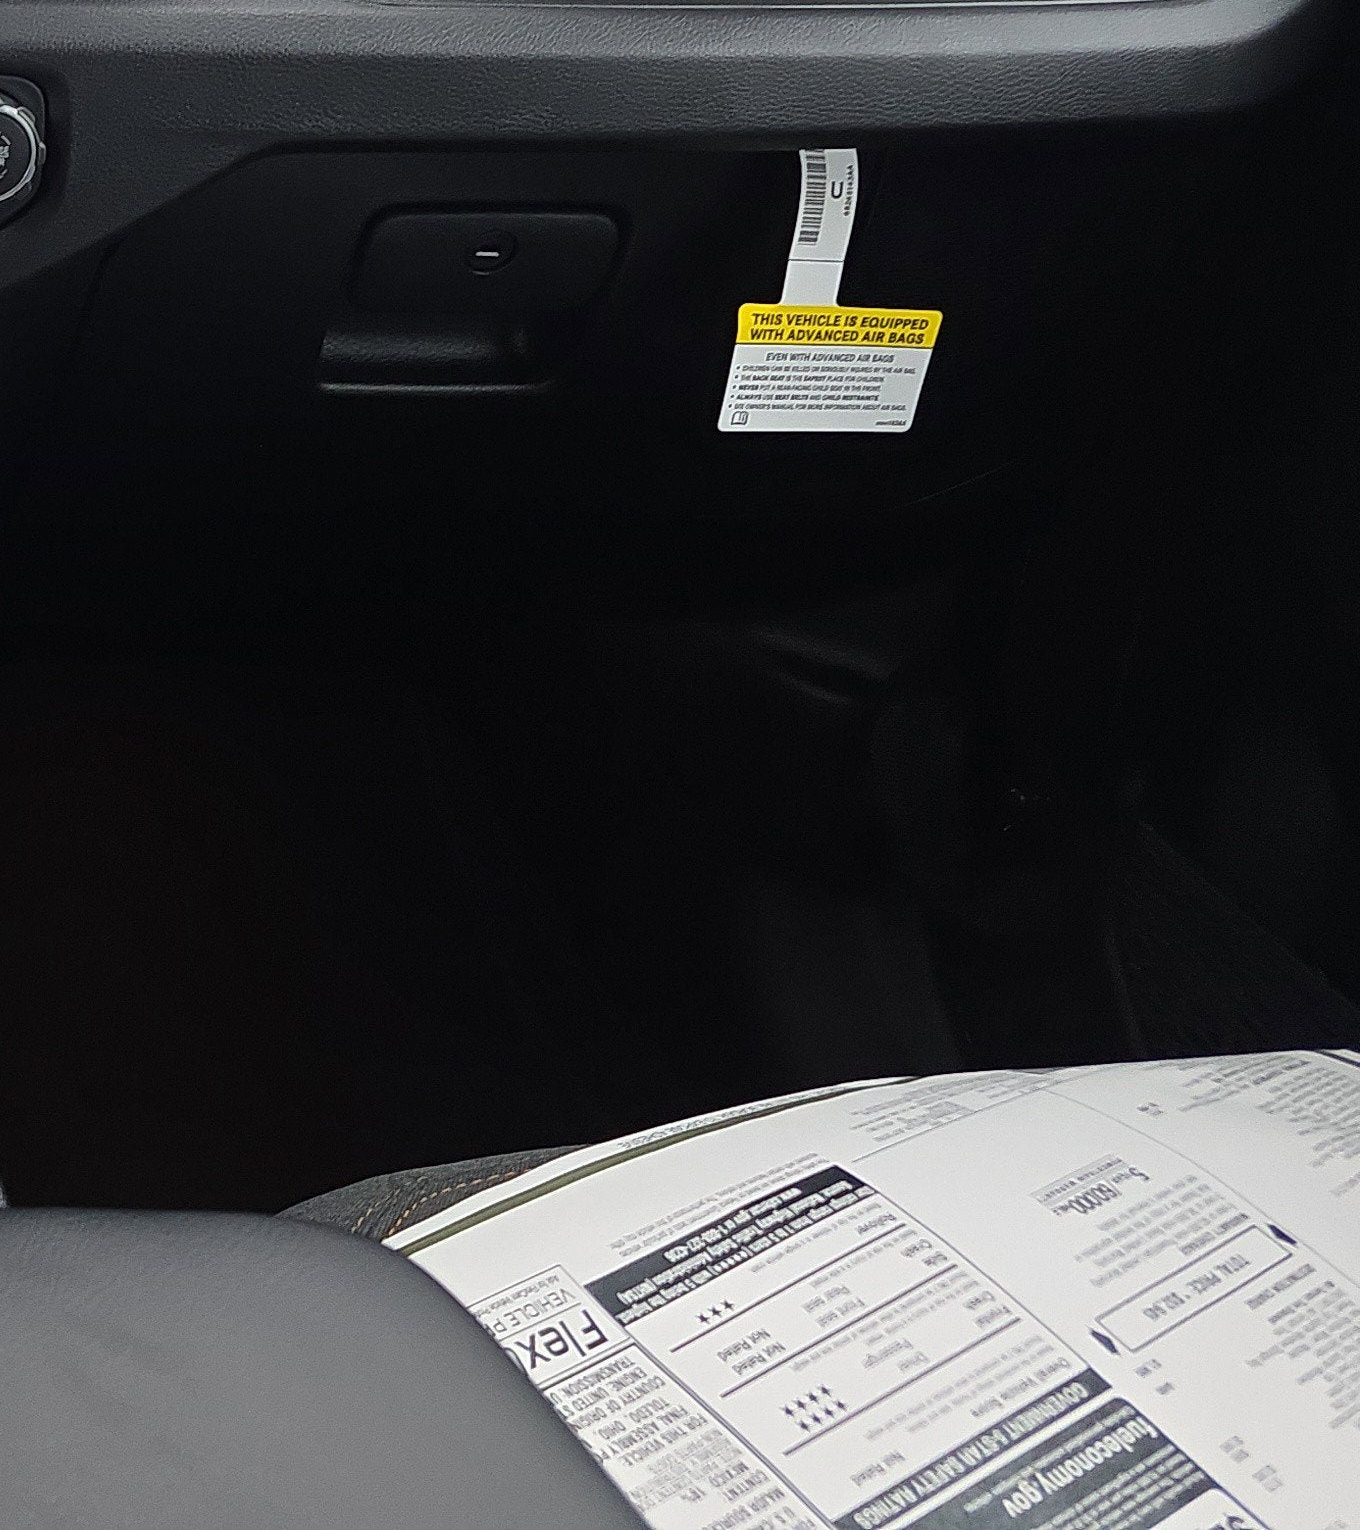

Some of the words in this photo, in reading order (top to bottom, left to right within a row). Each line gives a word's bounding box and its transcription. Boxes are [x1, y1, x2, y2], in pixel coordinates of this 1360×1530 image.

[830, 180, 844, 199] U
[750, 327, 784, 341] WITH
[787, 328, 859, 343] ADVANCED
[862, 330, 885, 344] AIR
[887, 332, 925, 345] BAGS
[751, 312, 783, 327] THIS
[785, 313, 842, 328] VEHICLE
[844, 315, 858, 328] IS
[859, 316, 930, 331] EQUIPPED
[765, 352, 788, 362] EVEN
[789, 352, 812, 362] WITH
[811, 352, 856, 363] ADVANCED
[503, 1287, 576, 1328] VEHICLE
[1003, 1381, 1090, 1440] GOVERNMENT
[912, 1455, 967, 1499] SAFETY
[1000, 1416, 1159, 1519] fueleconomy.gov
[852, 1489, 920, 1530] RATINGS
